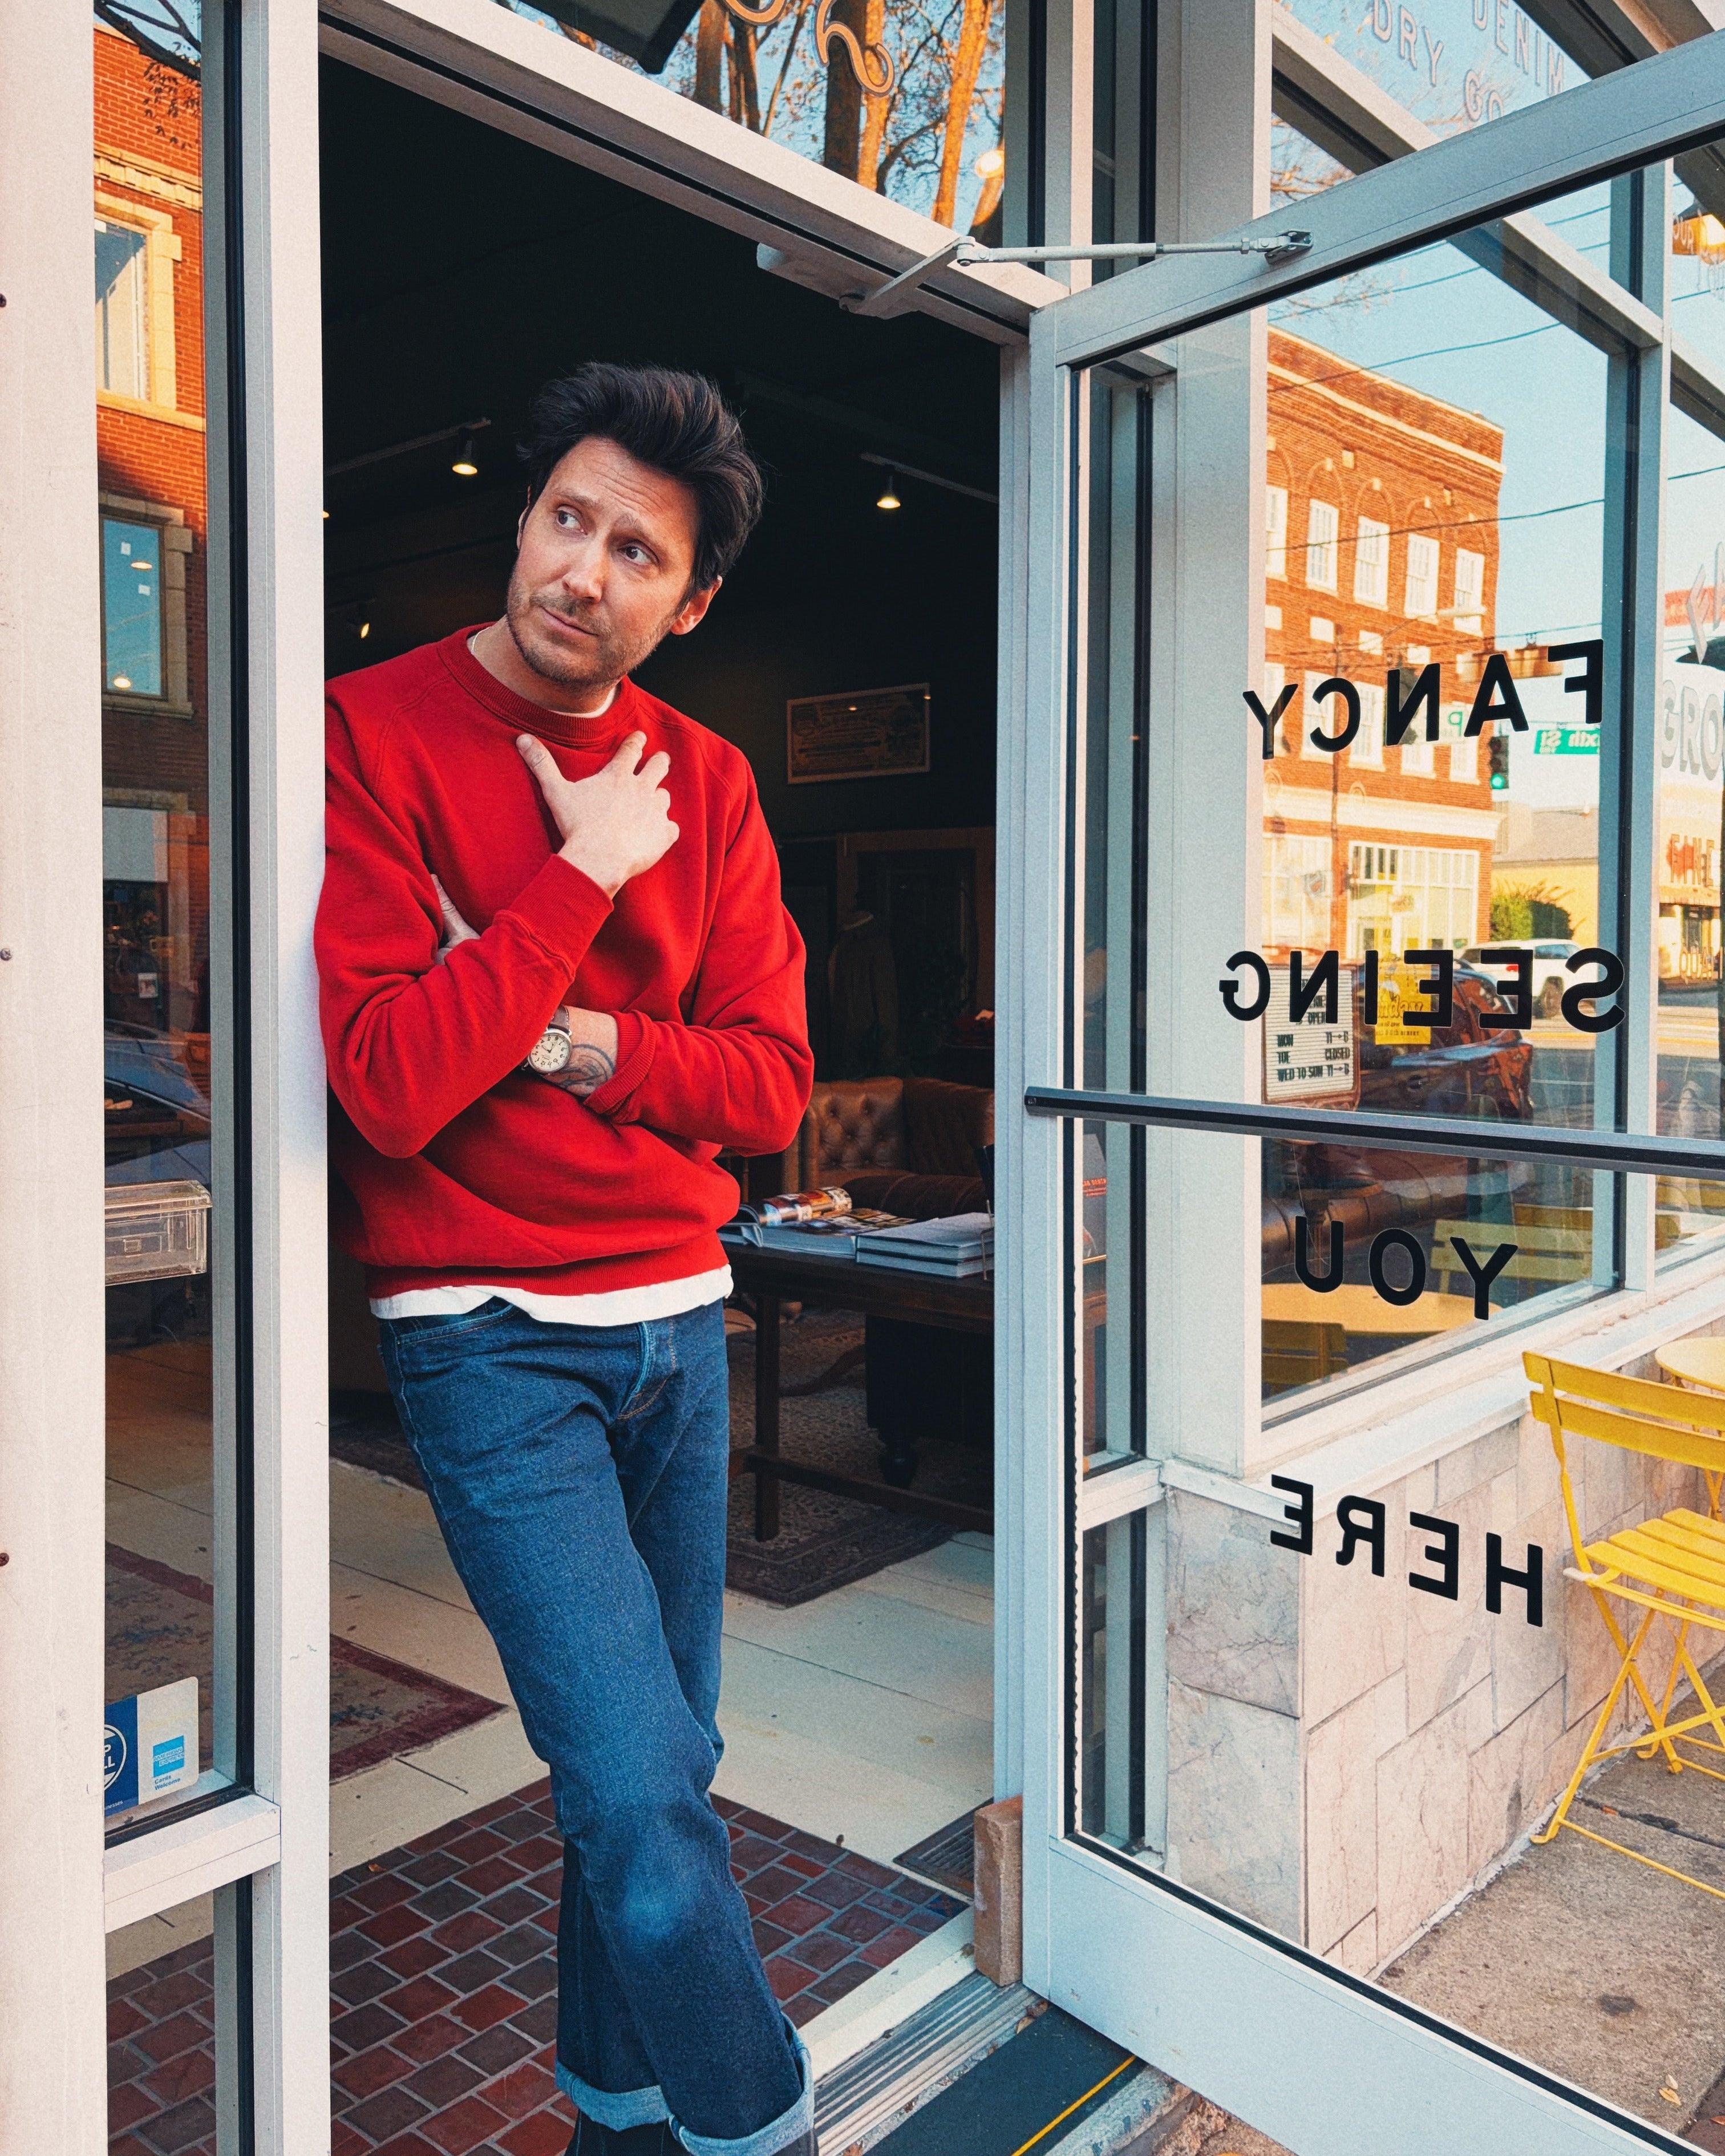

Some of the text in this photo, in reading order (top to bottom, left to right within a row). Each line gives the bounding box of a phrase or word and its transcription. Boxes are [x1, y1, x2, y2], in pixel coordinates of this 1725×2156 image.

[1373, 0, 1444, 87] DRY
[1325, 1047, 1350, 1060] CLOSED
[1277, 1068, 1295, 1082] WED
[1308, 1065, 1323, 1077] SUN
[153, 1746, 183, 1762] AMERICAN
[159, 1753, 184, 1767] EXPRESS
[155, 1775, 172, 1784] Cards
[155, 1777, 181, 1790] Welcome
